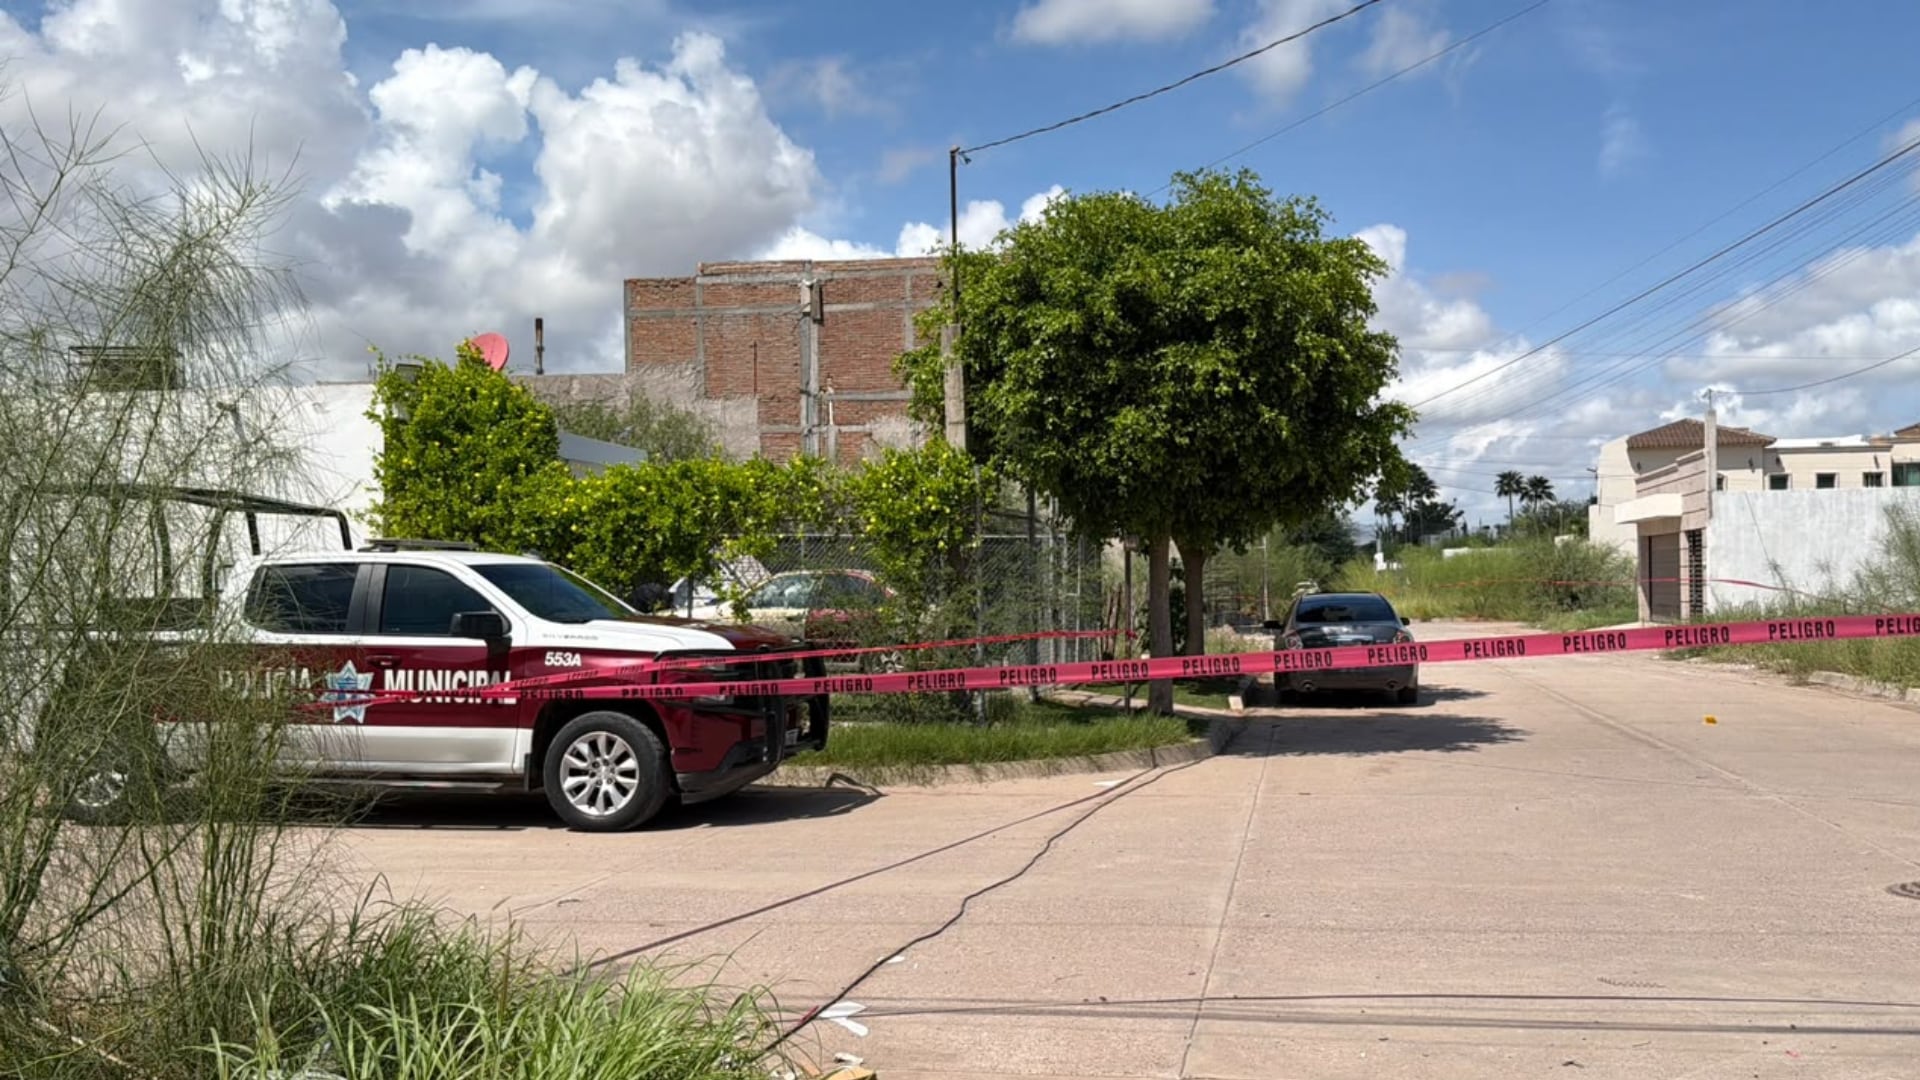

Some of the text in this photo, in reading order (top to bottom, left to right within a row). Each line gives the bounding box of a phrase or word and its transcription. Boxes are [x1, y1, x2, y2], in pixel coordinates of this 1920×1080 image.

[544, 651, 582, 666] 553A
[719, 682, 779, 695] PELIGRO
[814, 677, 873, 692] PELIGRO
[908, 672, 965, 689] PELIGRO
[1000, 667, 1057, 684] PELIGRO
[1091, 662, 1149, 680] PELIGRO
[1183, 657, 1241, 674] PELIGRO
[1274, 651, 1333, 670] PELIGRO
[1368, 645, 1428, 664] PELIGRO
[1464, 639, 1525, 658] PELIGRO
[1562, 633, 1627, 652] PELIGRO
[1664, 627, 1730, 645] PELIGRO
[1768, 620, 1836, 639] PELIGRO
[384, 668, 517, 704] MUNICIPAL
